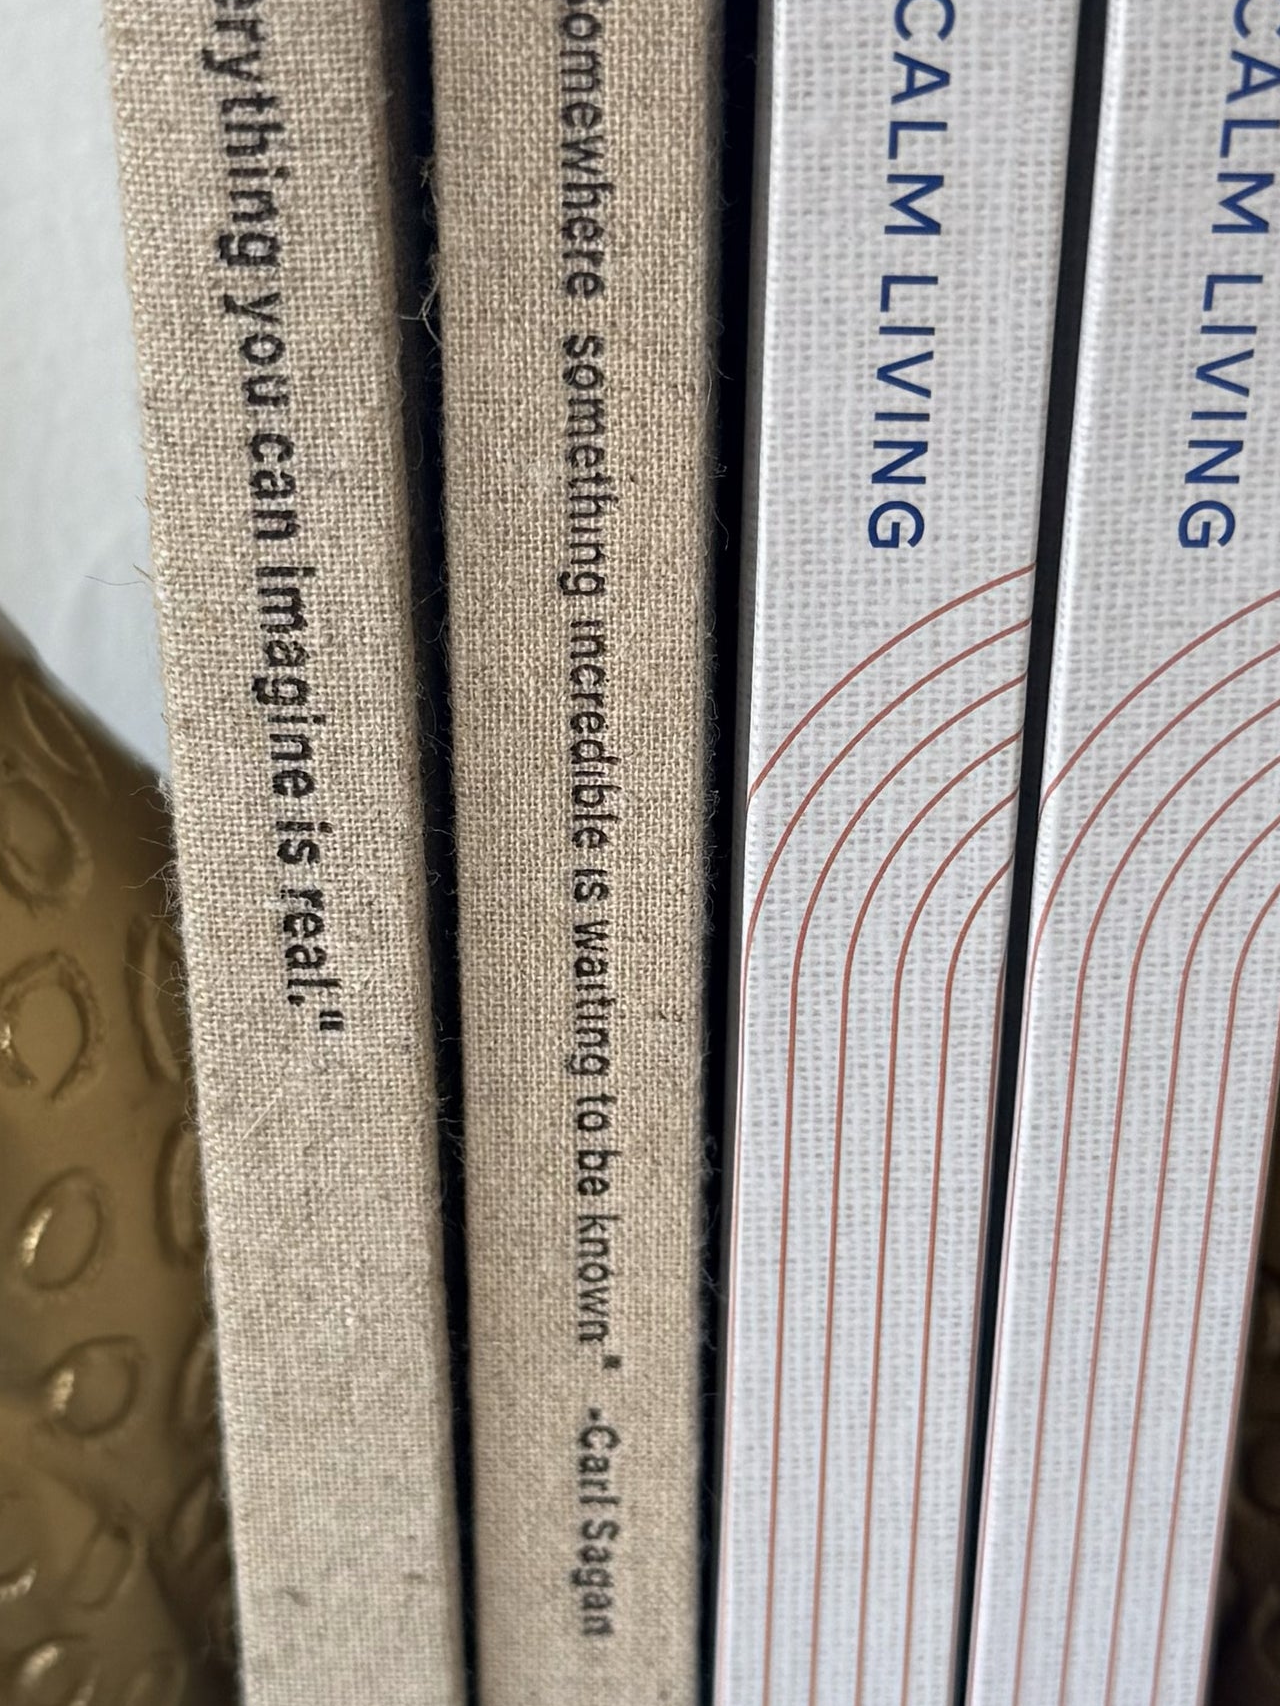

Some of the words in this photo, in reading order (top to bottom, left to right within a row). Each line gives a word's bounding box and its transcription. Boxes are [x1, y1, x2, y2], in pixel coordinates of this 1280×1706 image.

[223, 293, 288, 406] you
[867, 274, 939, 549] LIVING
[1177, 273, 1264, 550] LIVING
[249, 432, 300, 541] can
[558, 335, 619, 597] something
[251, 566, 327, 798] imagine
[569, 618, 622, 852] incredible
[275, 821, 333, 866] is
[572, 869, 612, 904] is
[280, 888, 344, 1033] real."
[565, 921, 620, 1081] waiting
[575, 1094, 614, 1133] to
[577, 1149, 621, 1198] be
[569, 1518, 620, 1637] Sagan
